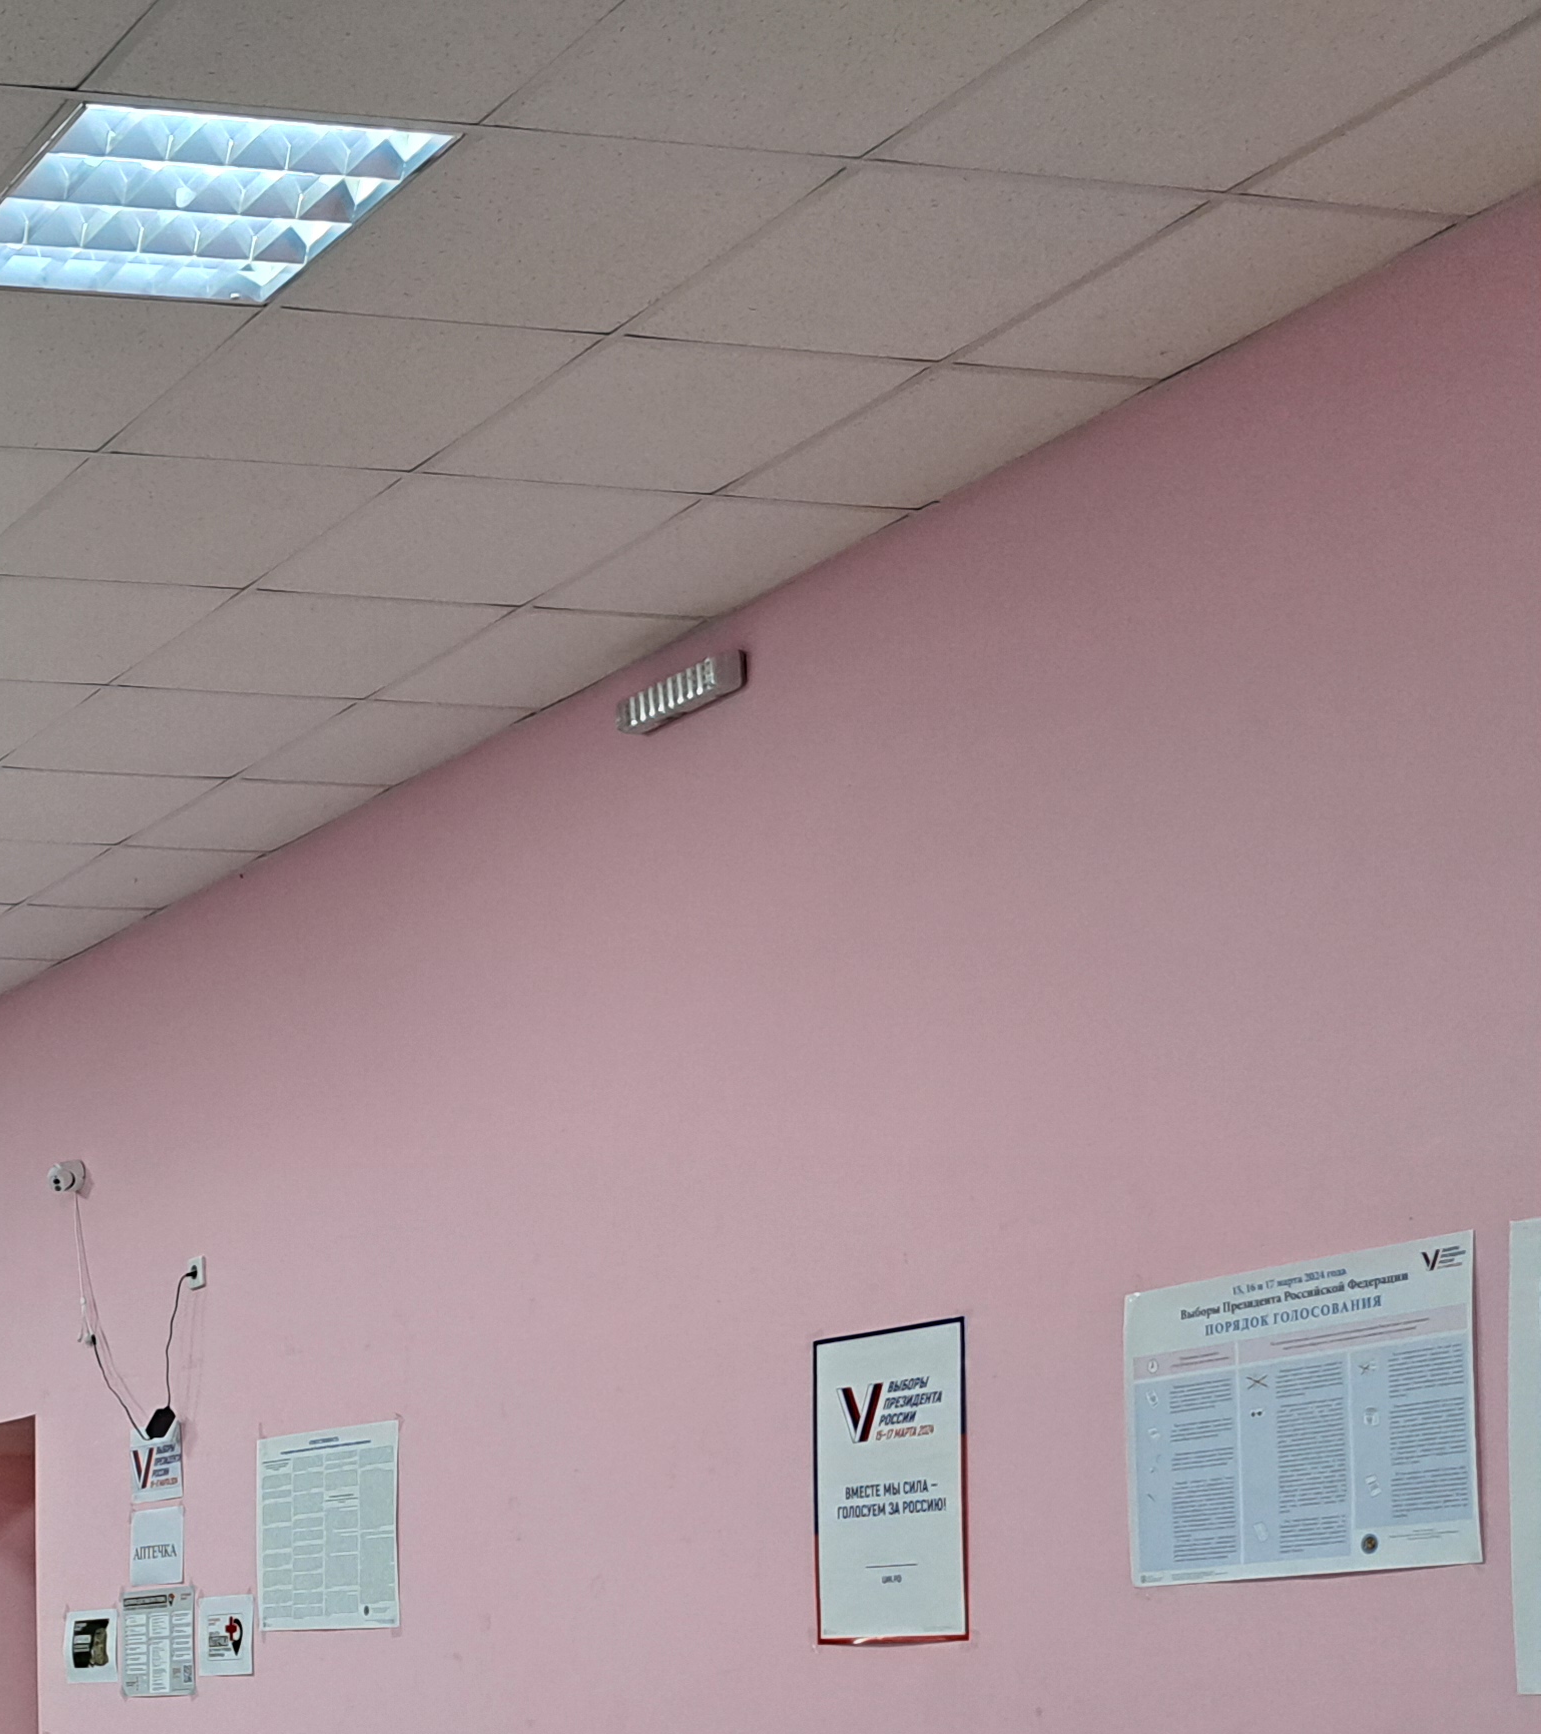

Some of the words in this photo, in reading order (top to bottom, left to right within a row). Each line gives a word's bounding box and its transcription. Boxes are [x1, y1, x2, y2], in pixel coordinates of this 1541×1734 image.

[1277, 1275, 1303, 1289] марта
[1304, 1270, 1325, 1284] 2024
[1326, 1267, 1347, 1281] года
[1180, 1305, 1221, 1321] Выборы
[1222, 1295, 1283, 1316] Президента
[1284, 1281, 1346, 1303] Российской
[1347, 1272, 1409, 1291] Федерации
[1204, 1313, 1270, 1337] ПОРЯДОК
[1272, 1294, 1383, 1326] ГОЛОСОВАНИЯ
[887, 1375, 930, 1393] ВЫБОРЫ
[882, 1390, 943, 1411] ПРЕЗИДЕНТА
[878, 1409, 918, 1427] РОССИИ
[845, 1483, 881, 1500] ВМЕСТЕ
[883, 1482, 901, 1497] МЫ
[903, 1479, 929, 1495] СИЛА
[837, 1503, 886, 1520] ГОЛОСУЕМ
[888, 1501, 901, 1516] ЗА
[902, 1497, 947, 1515] РОССИЮ!
[133, 1543, 178, 1561] АПТЕЧКА
